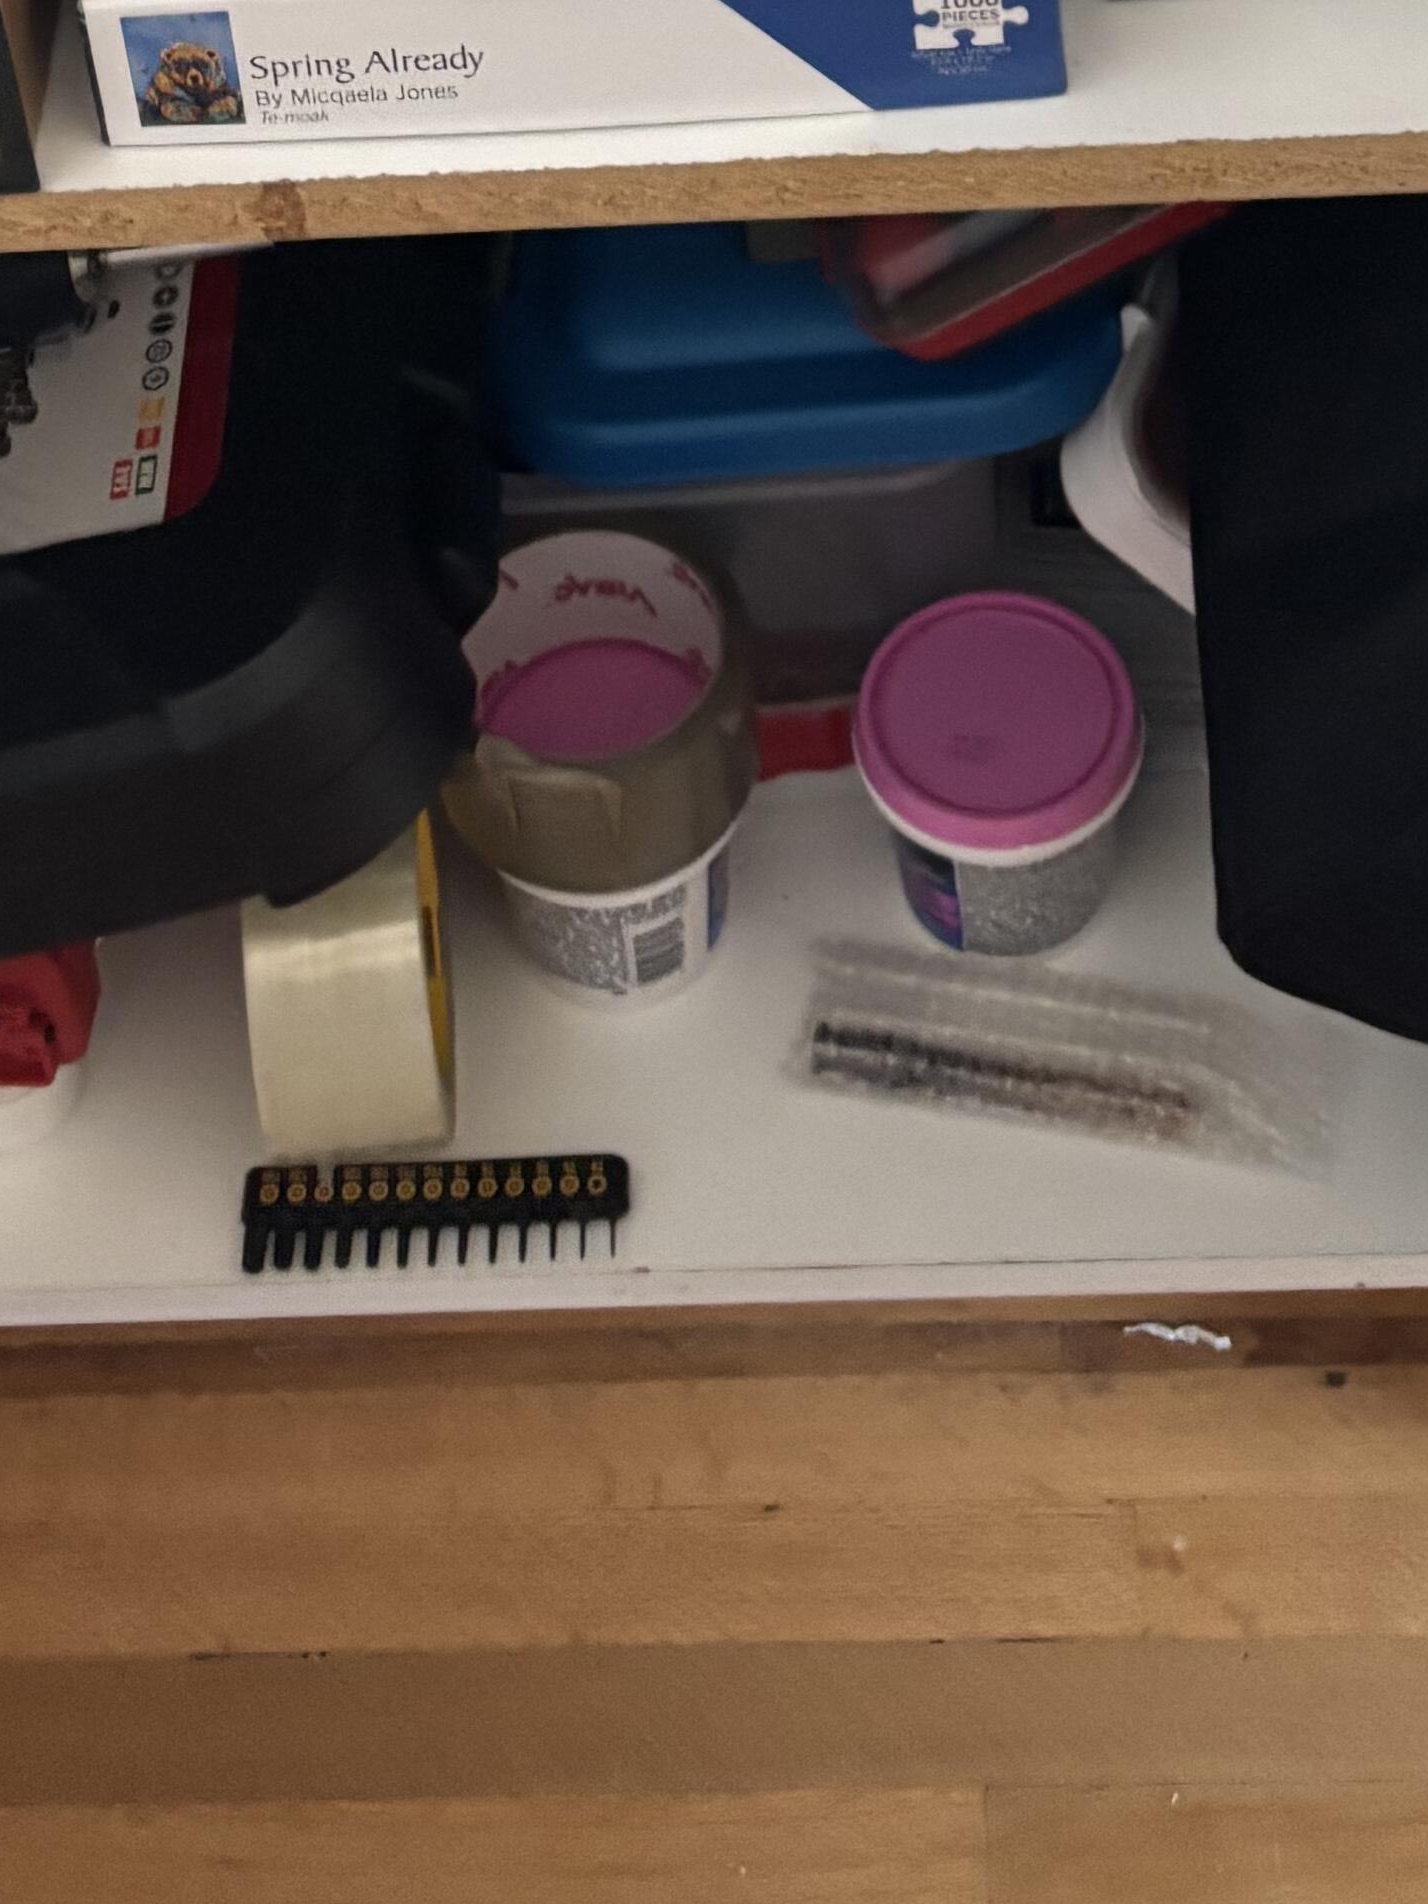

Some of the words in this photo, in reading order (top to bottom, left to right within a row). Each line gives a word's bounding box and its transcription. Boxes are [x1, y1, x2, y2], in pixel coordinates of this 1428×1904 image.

[941, 9, 1001, 23] PIECES
[250, 50, 357, 86] Spring
[364, 44, 485, 79] Already
[254, 87, 286, 109] By
[394, 80, 459, 104] Jones
